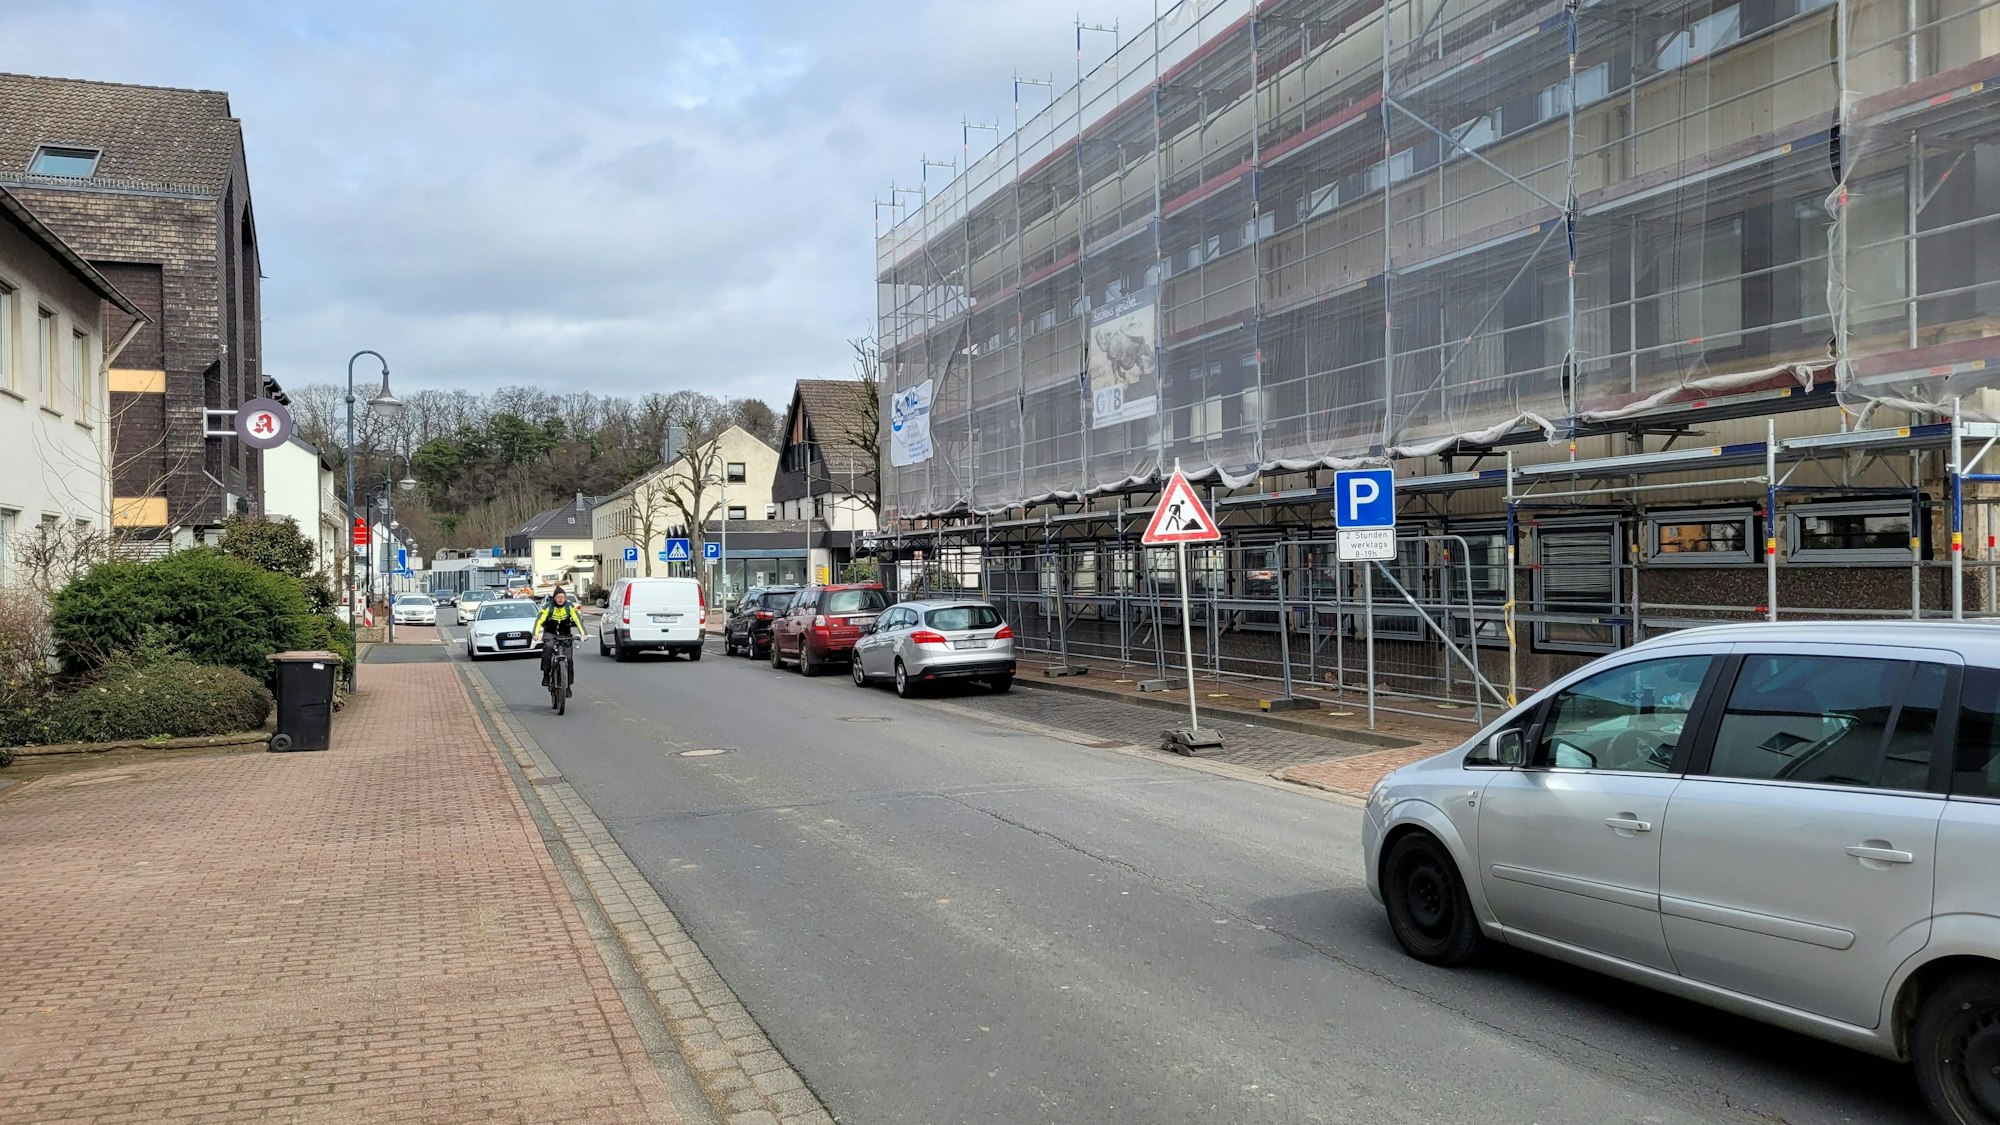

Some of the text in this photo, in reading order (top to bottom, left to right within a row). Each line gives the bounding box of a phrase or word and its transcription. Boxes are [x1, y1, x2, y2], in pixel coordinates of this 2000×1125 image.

[1096, 387, 1122, 416] GTB
[1349, 477, 1380, 520] P
[1346, 531, 1388, 540] 2 Stunden
[707, 544, 717, 557] P
[1350, 541, 1388, 549] werktags
[626, 549, 635, 560] P
[1355, 550, 1378, 558] 8-19h
